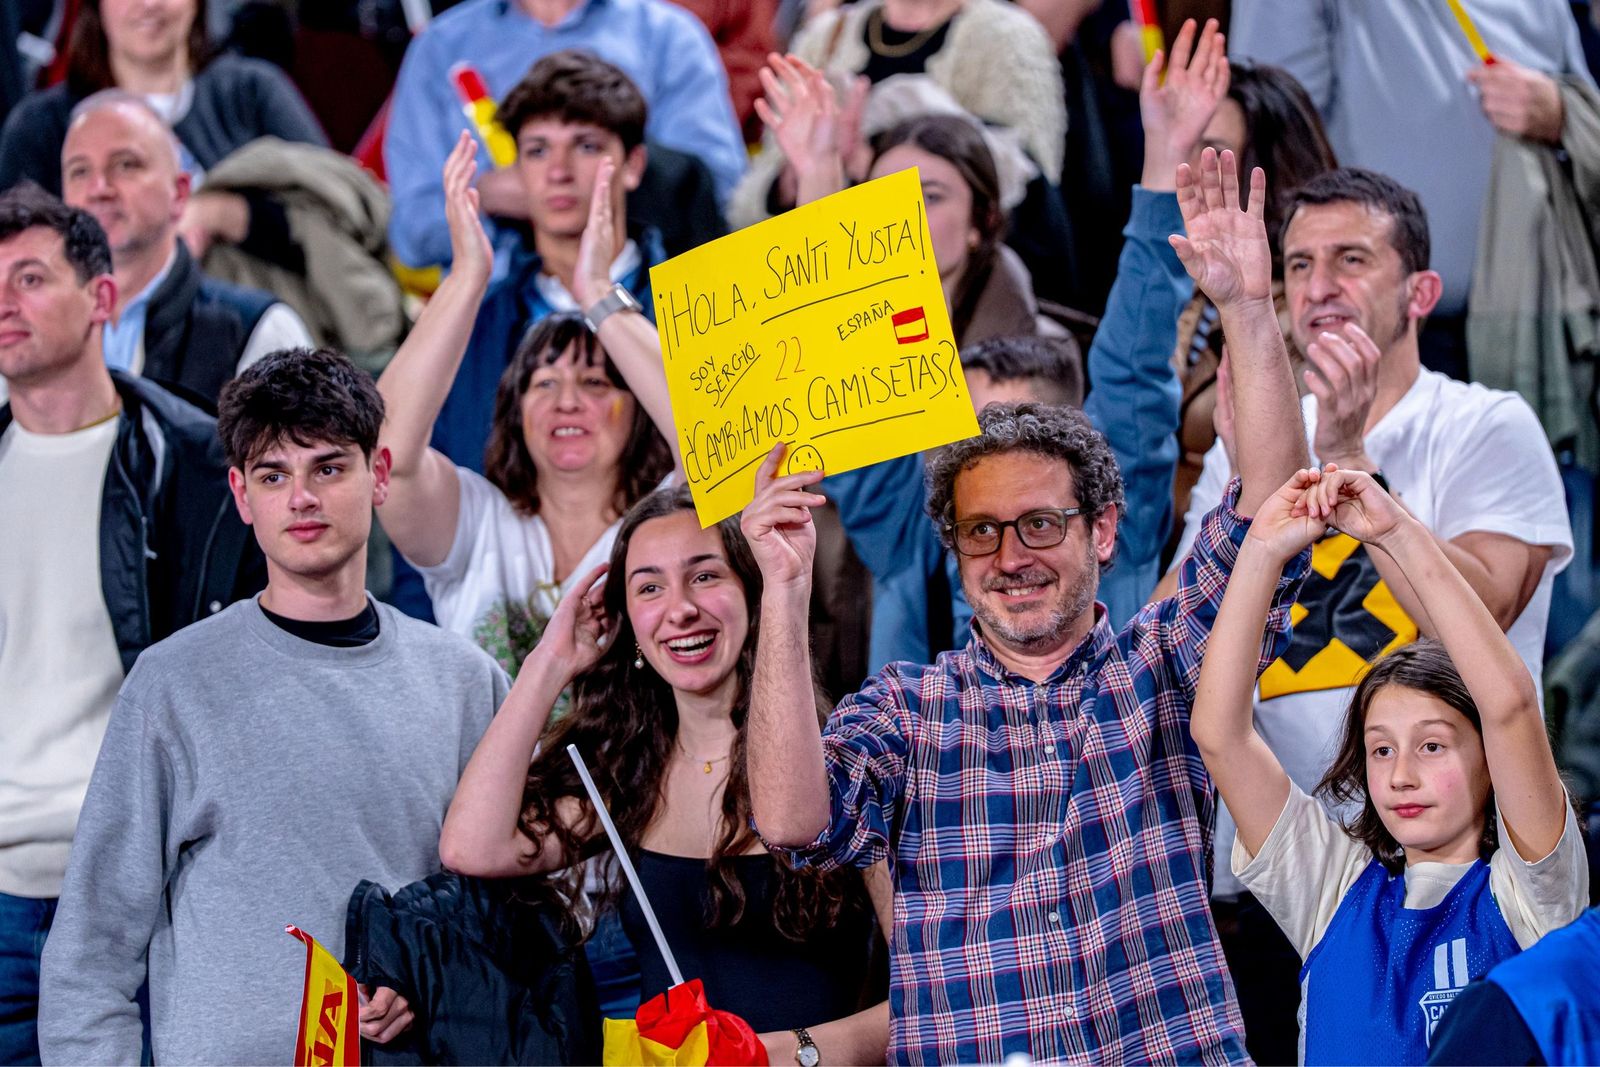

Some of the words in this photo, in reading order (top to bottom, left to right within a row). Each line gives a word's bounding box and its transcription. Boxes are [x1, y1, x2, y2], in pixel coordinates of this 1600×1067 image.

[659, 283, 757, 360] ¡HOLA,
[838, 200, 926, 276] YUSTA!
[836, 299, 895, 341] ESPAÑA
[689, 355, 716, 392] SOY
[775, 336, 806, 382] 22
